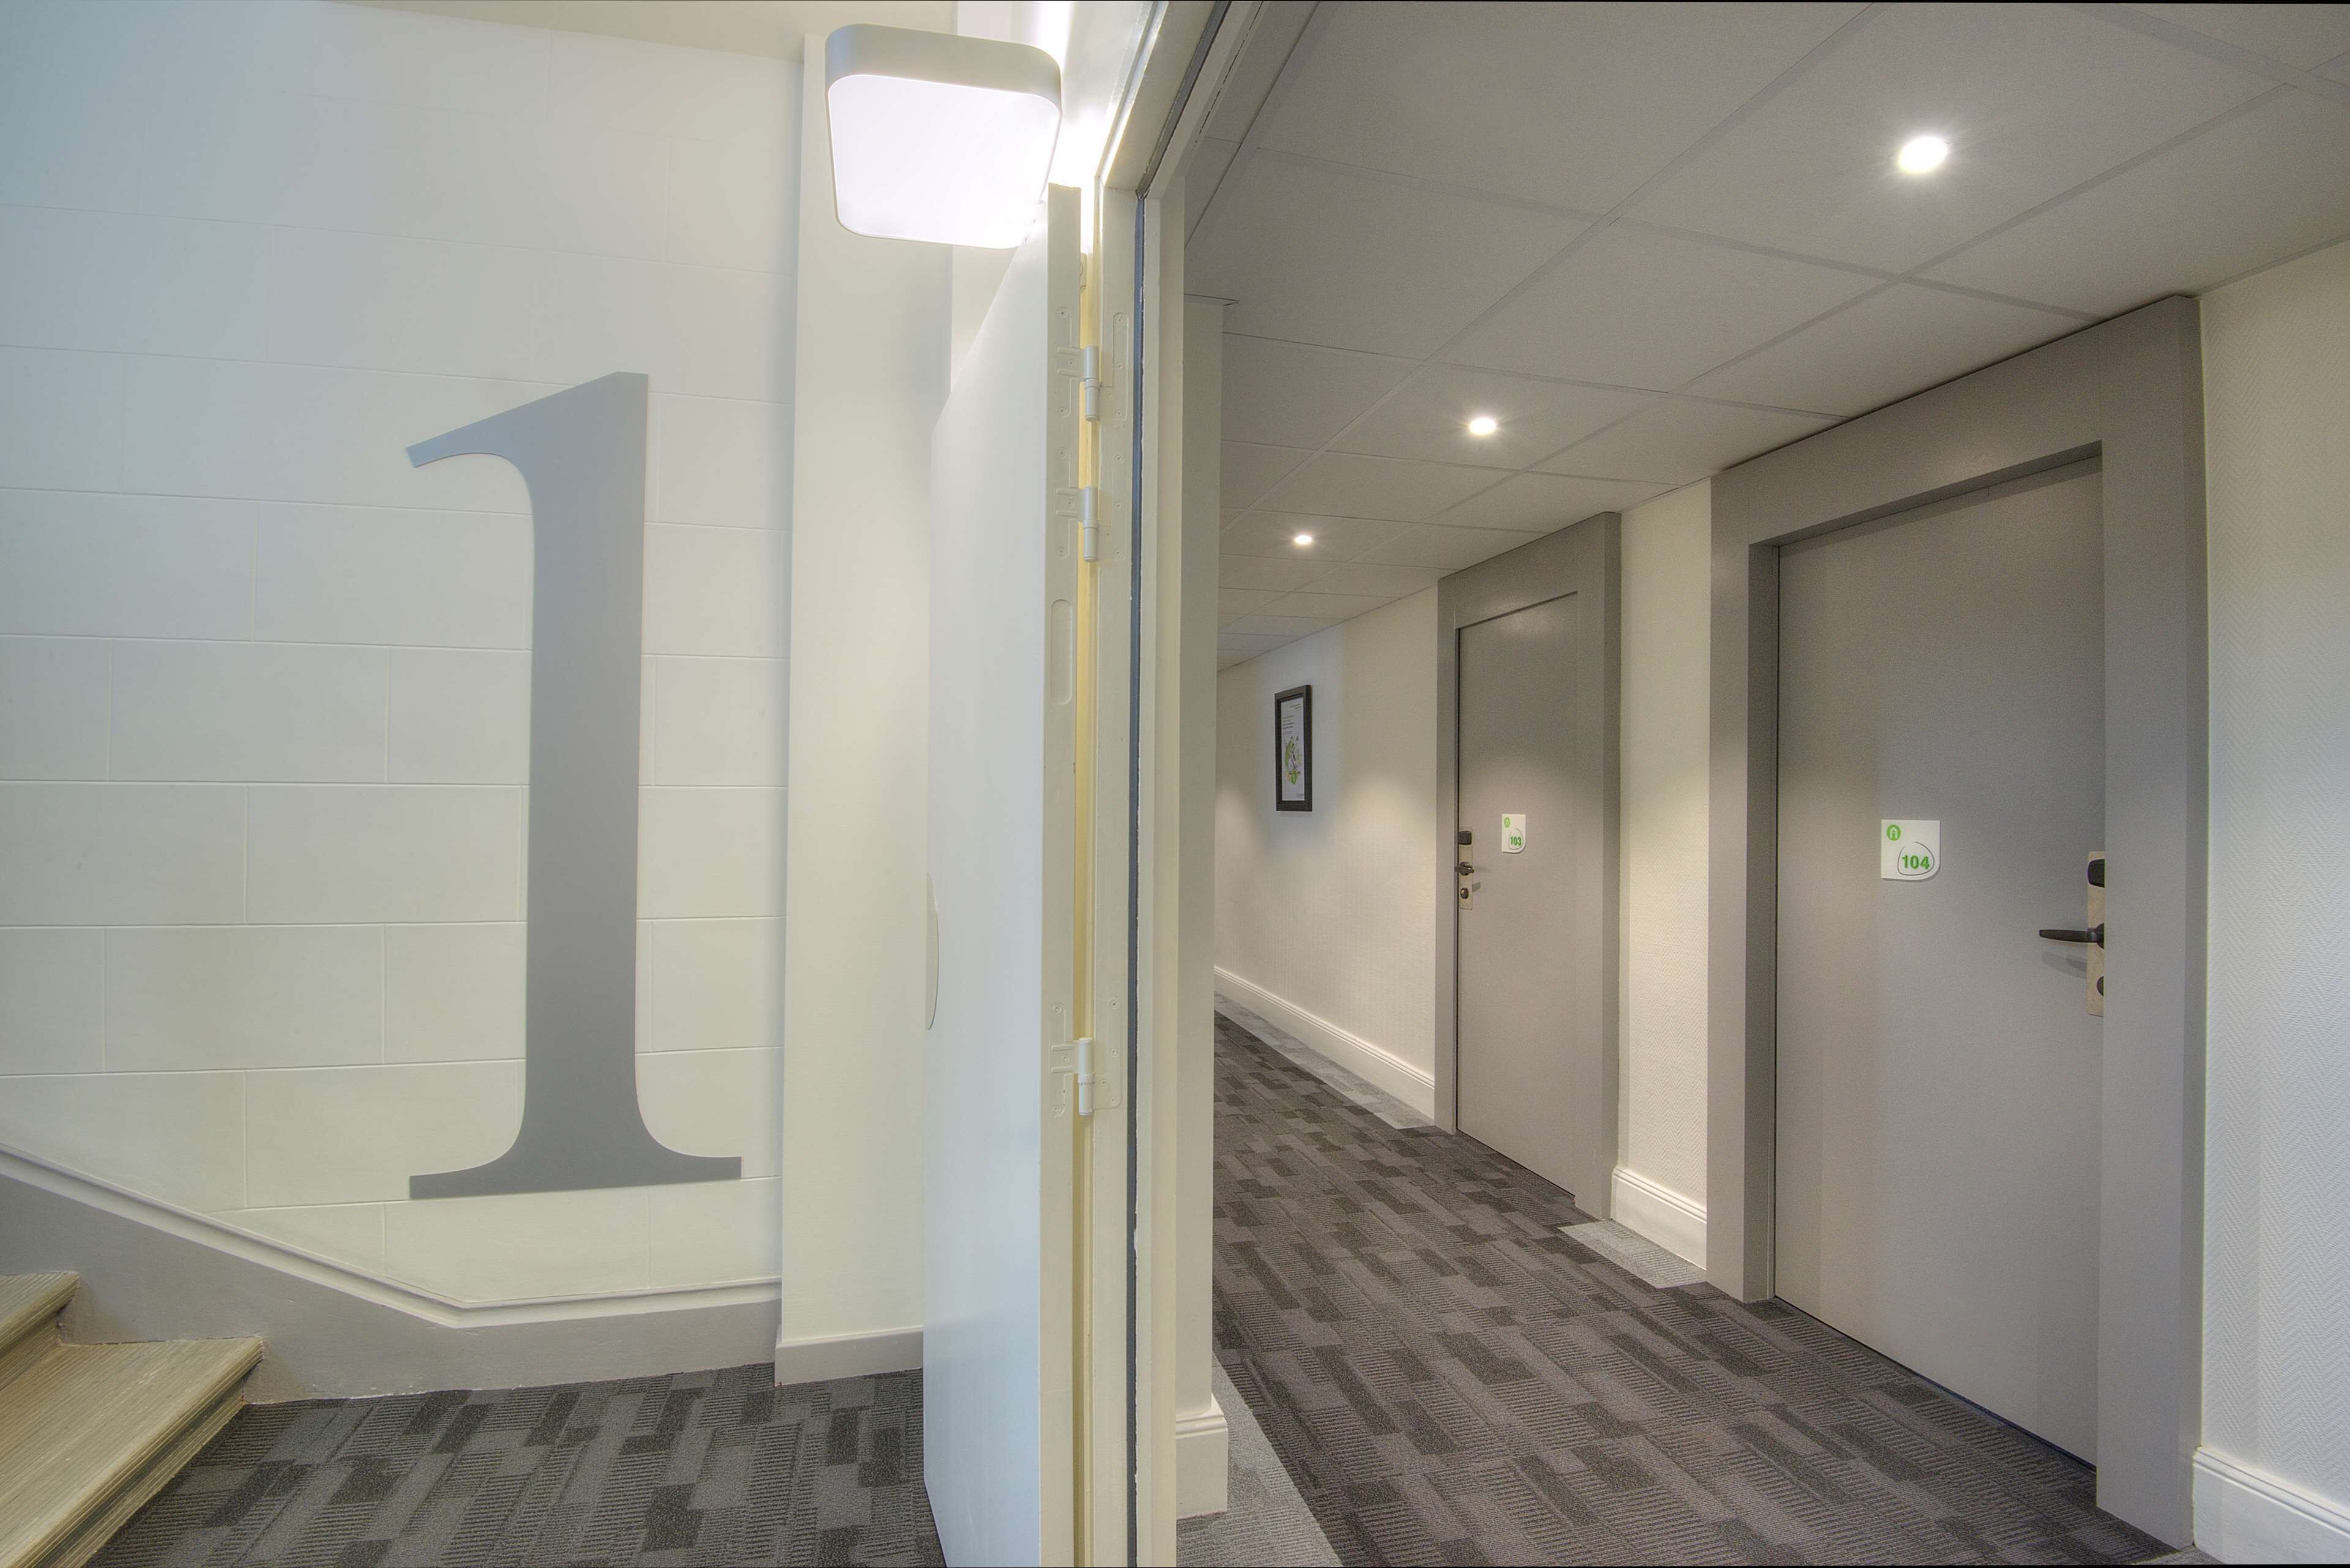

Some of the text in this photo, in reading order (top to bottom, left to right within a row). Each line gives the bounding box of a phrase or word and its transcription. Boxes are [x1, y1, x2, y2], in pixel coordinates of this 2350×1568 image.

[406, 371, 741, 1200] 1
[1510, 836, 1522, 846] 103
[1902, 855, 1929, 869] 104
